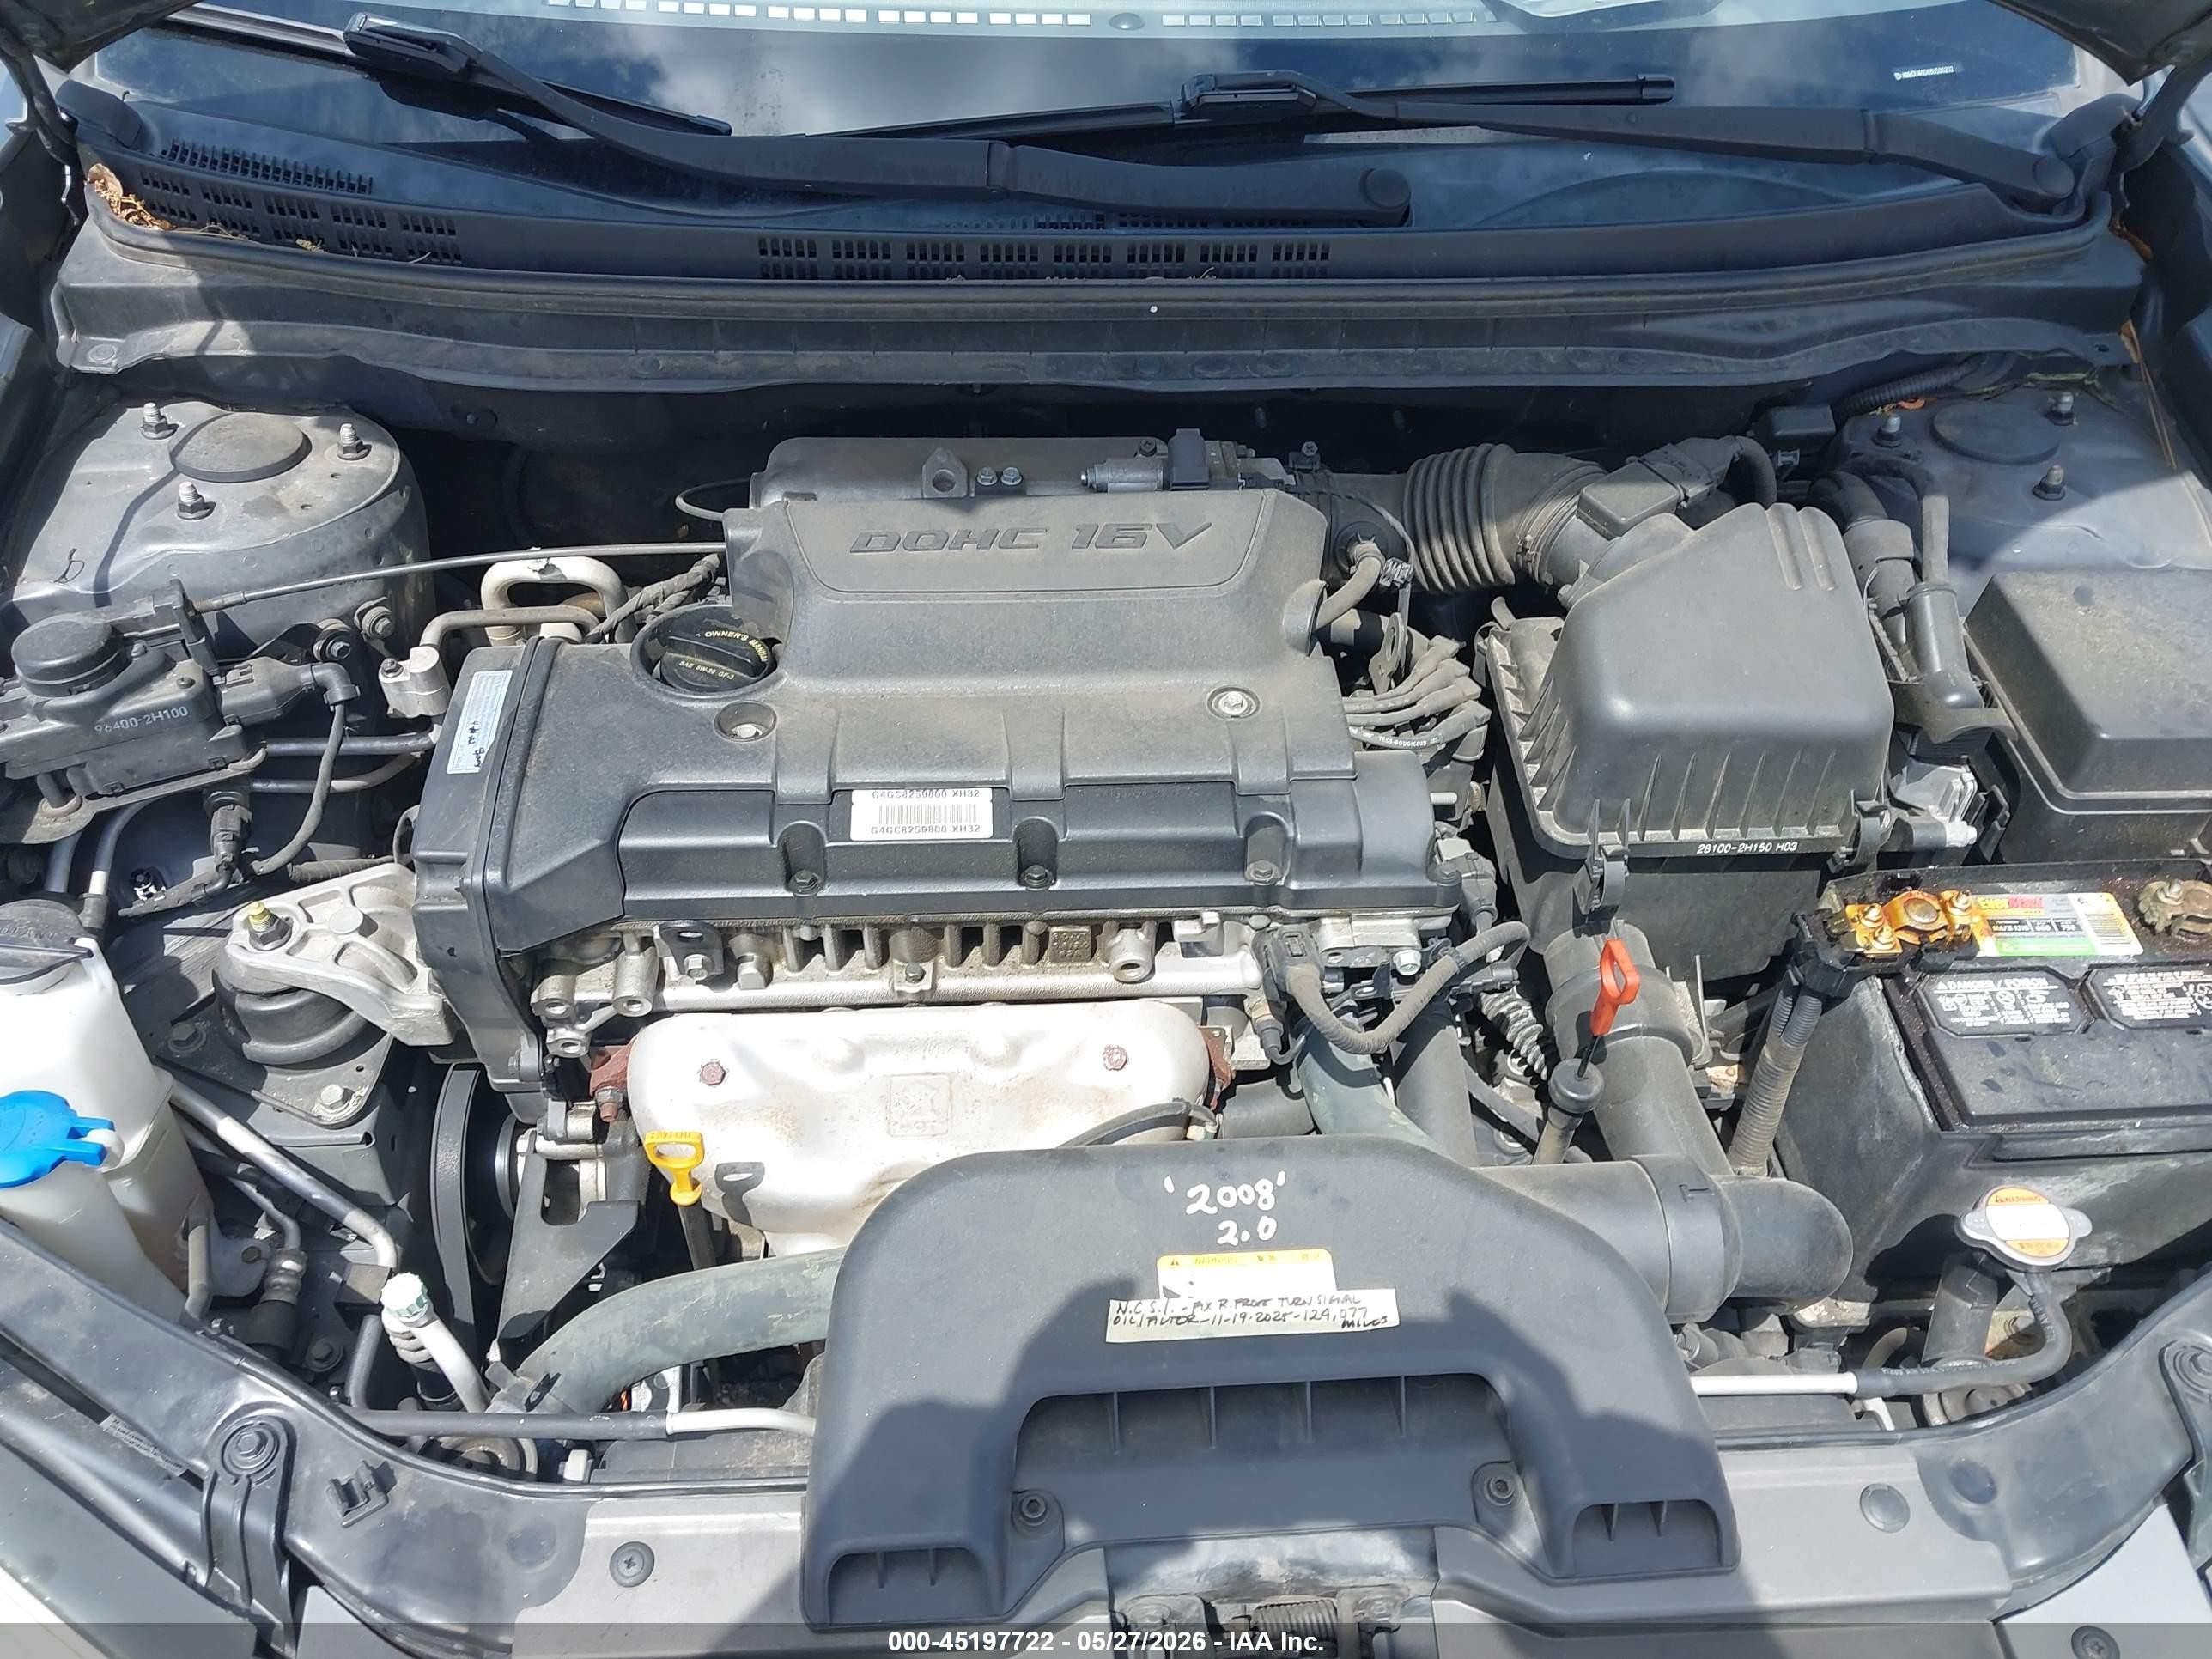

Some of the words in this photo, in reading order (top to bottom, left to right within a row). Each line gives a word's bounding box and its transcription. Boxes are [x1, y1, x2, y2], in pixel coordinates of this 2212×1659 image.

[849, 527, 1048, 554] DOHC
[1071, 522, 1212, 550] 16V
[704, 629, 750, 641] OWNER'S
[678, 659, 694, 670] SAE
[94, 706, 189, 733] 96400-2H100
[951, 788, 981, 799] XH32
[951, 824, 981, 834] XH32
[1696, 842, 1773, 854] 28100-2H150
[1775, 841, 1799, 852] H03
[1217, 1215, 1278, 1246] 2.0
[1277, 1297, 1313, 1308] TURN
